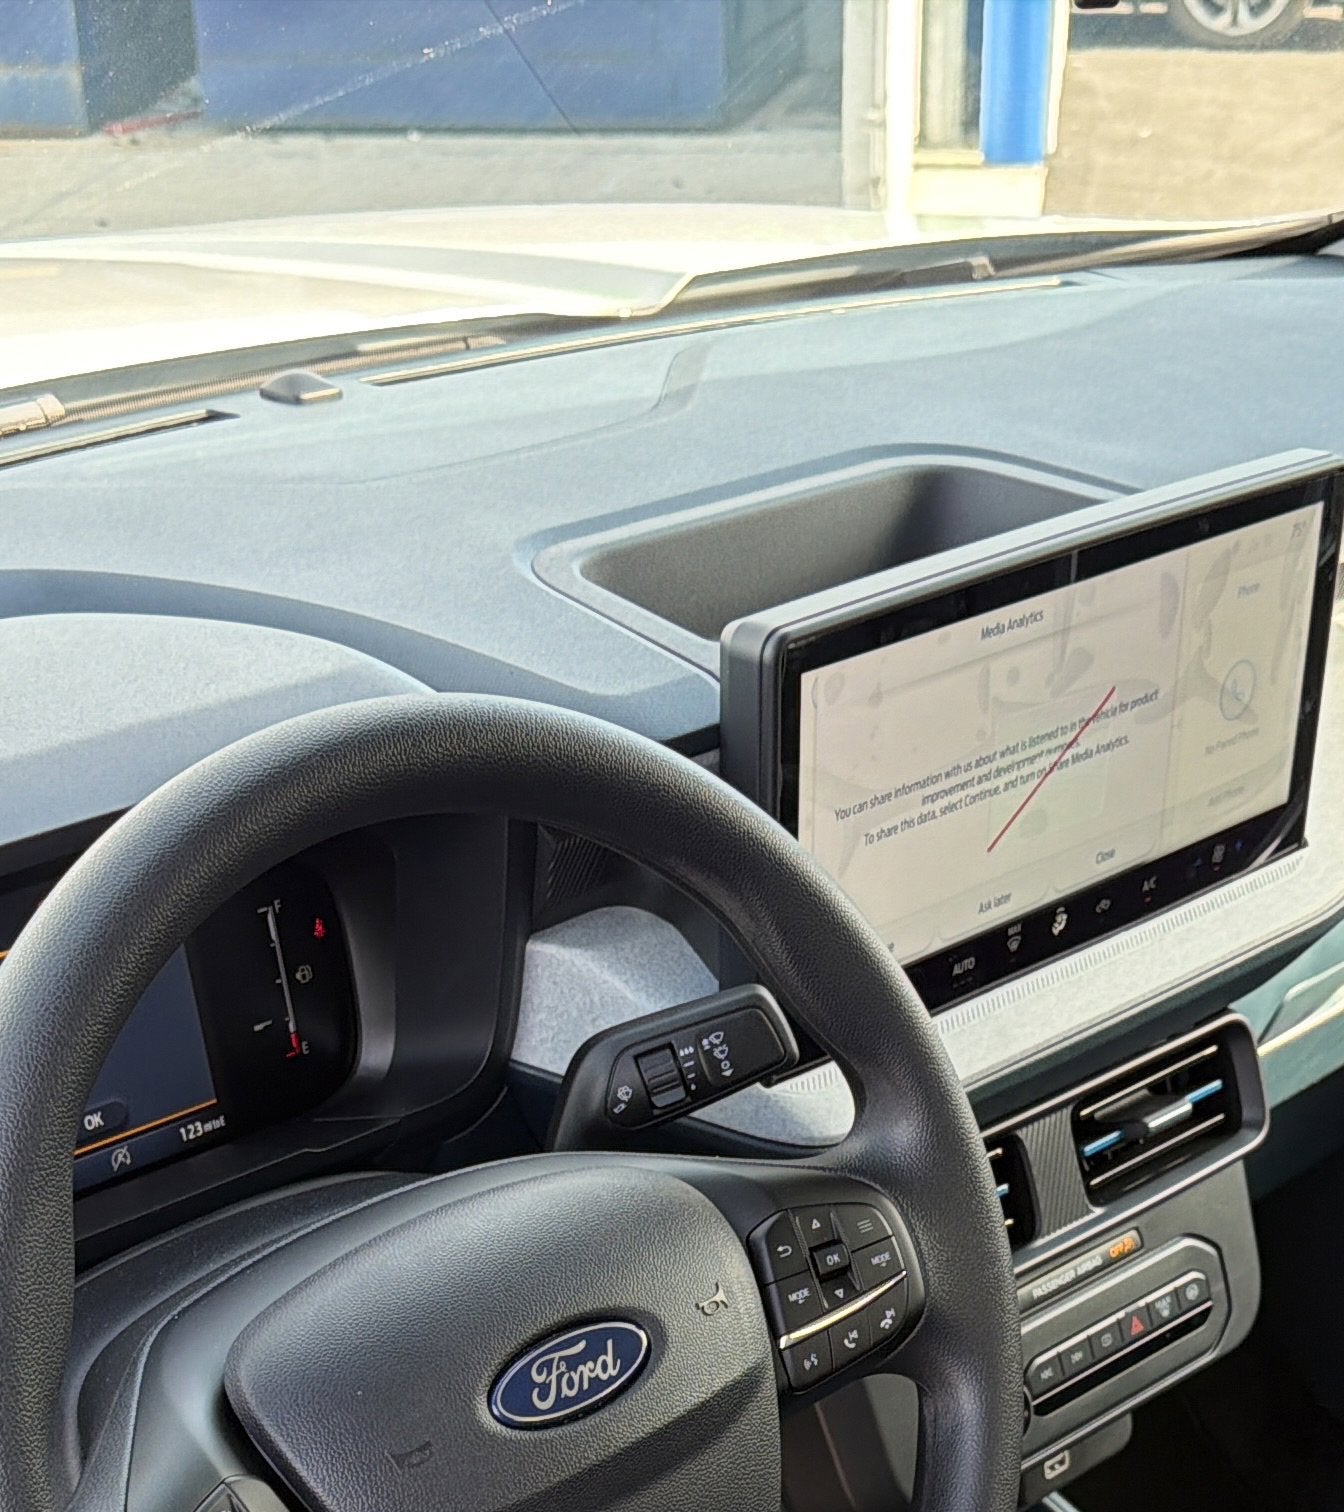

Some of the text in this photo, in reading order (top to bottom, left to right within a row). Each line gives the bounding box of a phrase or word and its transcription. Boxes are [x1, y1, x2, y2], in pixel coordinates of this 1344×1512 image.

[980, 610, 1044, 641] Media Analytics
[834, 807, 852, 822] You
[852, 801, 868, 815] can
[869, 791, 893, 809] share
[894, 772, 943, 799] information
[944, 763, 963, 780] with
[974, 750, 998, 770] about
[998, 742, 1020, 759] what
[1028, 726, 1059, 745] listened
[1117, 700, 1130, 714] for
[1130, 689, 1160, 712] product
[863, 832, 875, 847] To
[875, 823, 899, 842] share
[899, 815, 916, 832] this
[939, 797, 964, 818] select
[1002, 777, 1019, 793] and
[1019, 770, 1036, 786] turn
[1070, 748, 1094, 767] Media
[921, 776, 980, 806] improvement
[976, 769, 993, 785] and
[1095, 848, 1116, 865] Close
[273, 898, 283, 914] F
[978, 892, 1012, 915] Ask later
[1007, 922, 1023, 937] MAX
[951, 956, 977, 977] AUTO
[302, 1041, 310, 1055] E
[83, 1111, 105, 1131] OK
[178, 1120, 204, 1143] 123
[826, 1252, 841, 1266] OK
[870, 1251, 892, 1266] MODE
[1032, 1269, 1077, 1300] PASSENGER
[1076, 1254, 1104, 1276] AIRBAG
[787, 1287, 811, 1303] MODE
[530, 1338, 621, 1411] Ford
